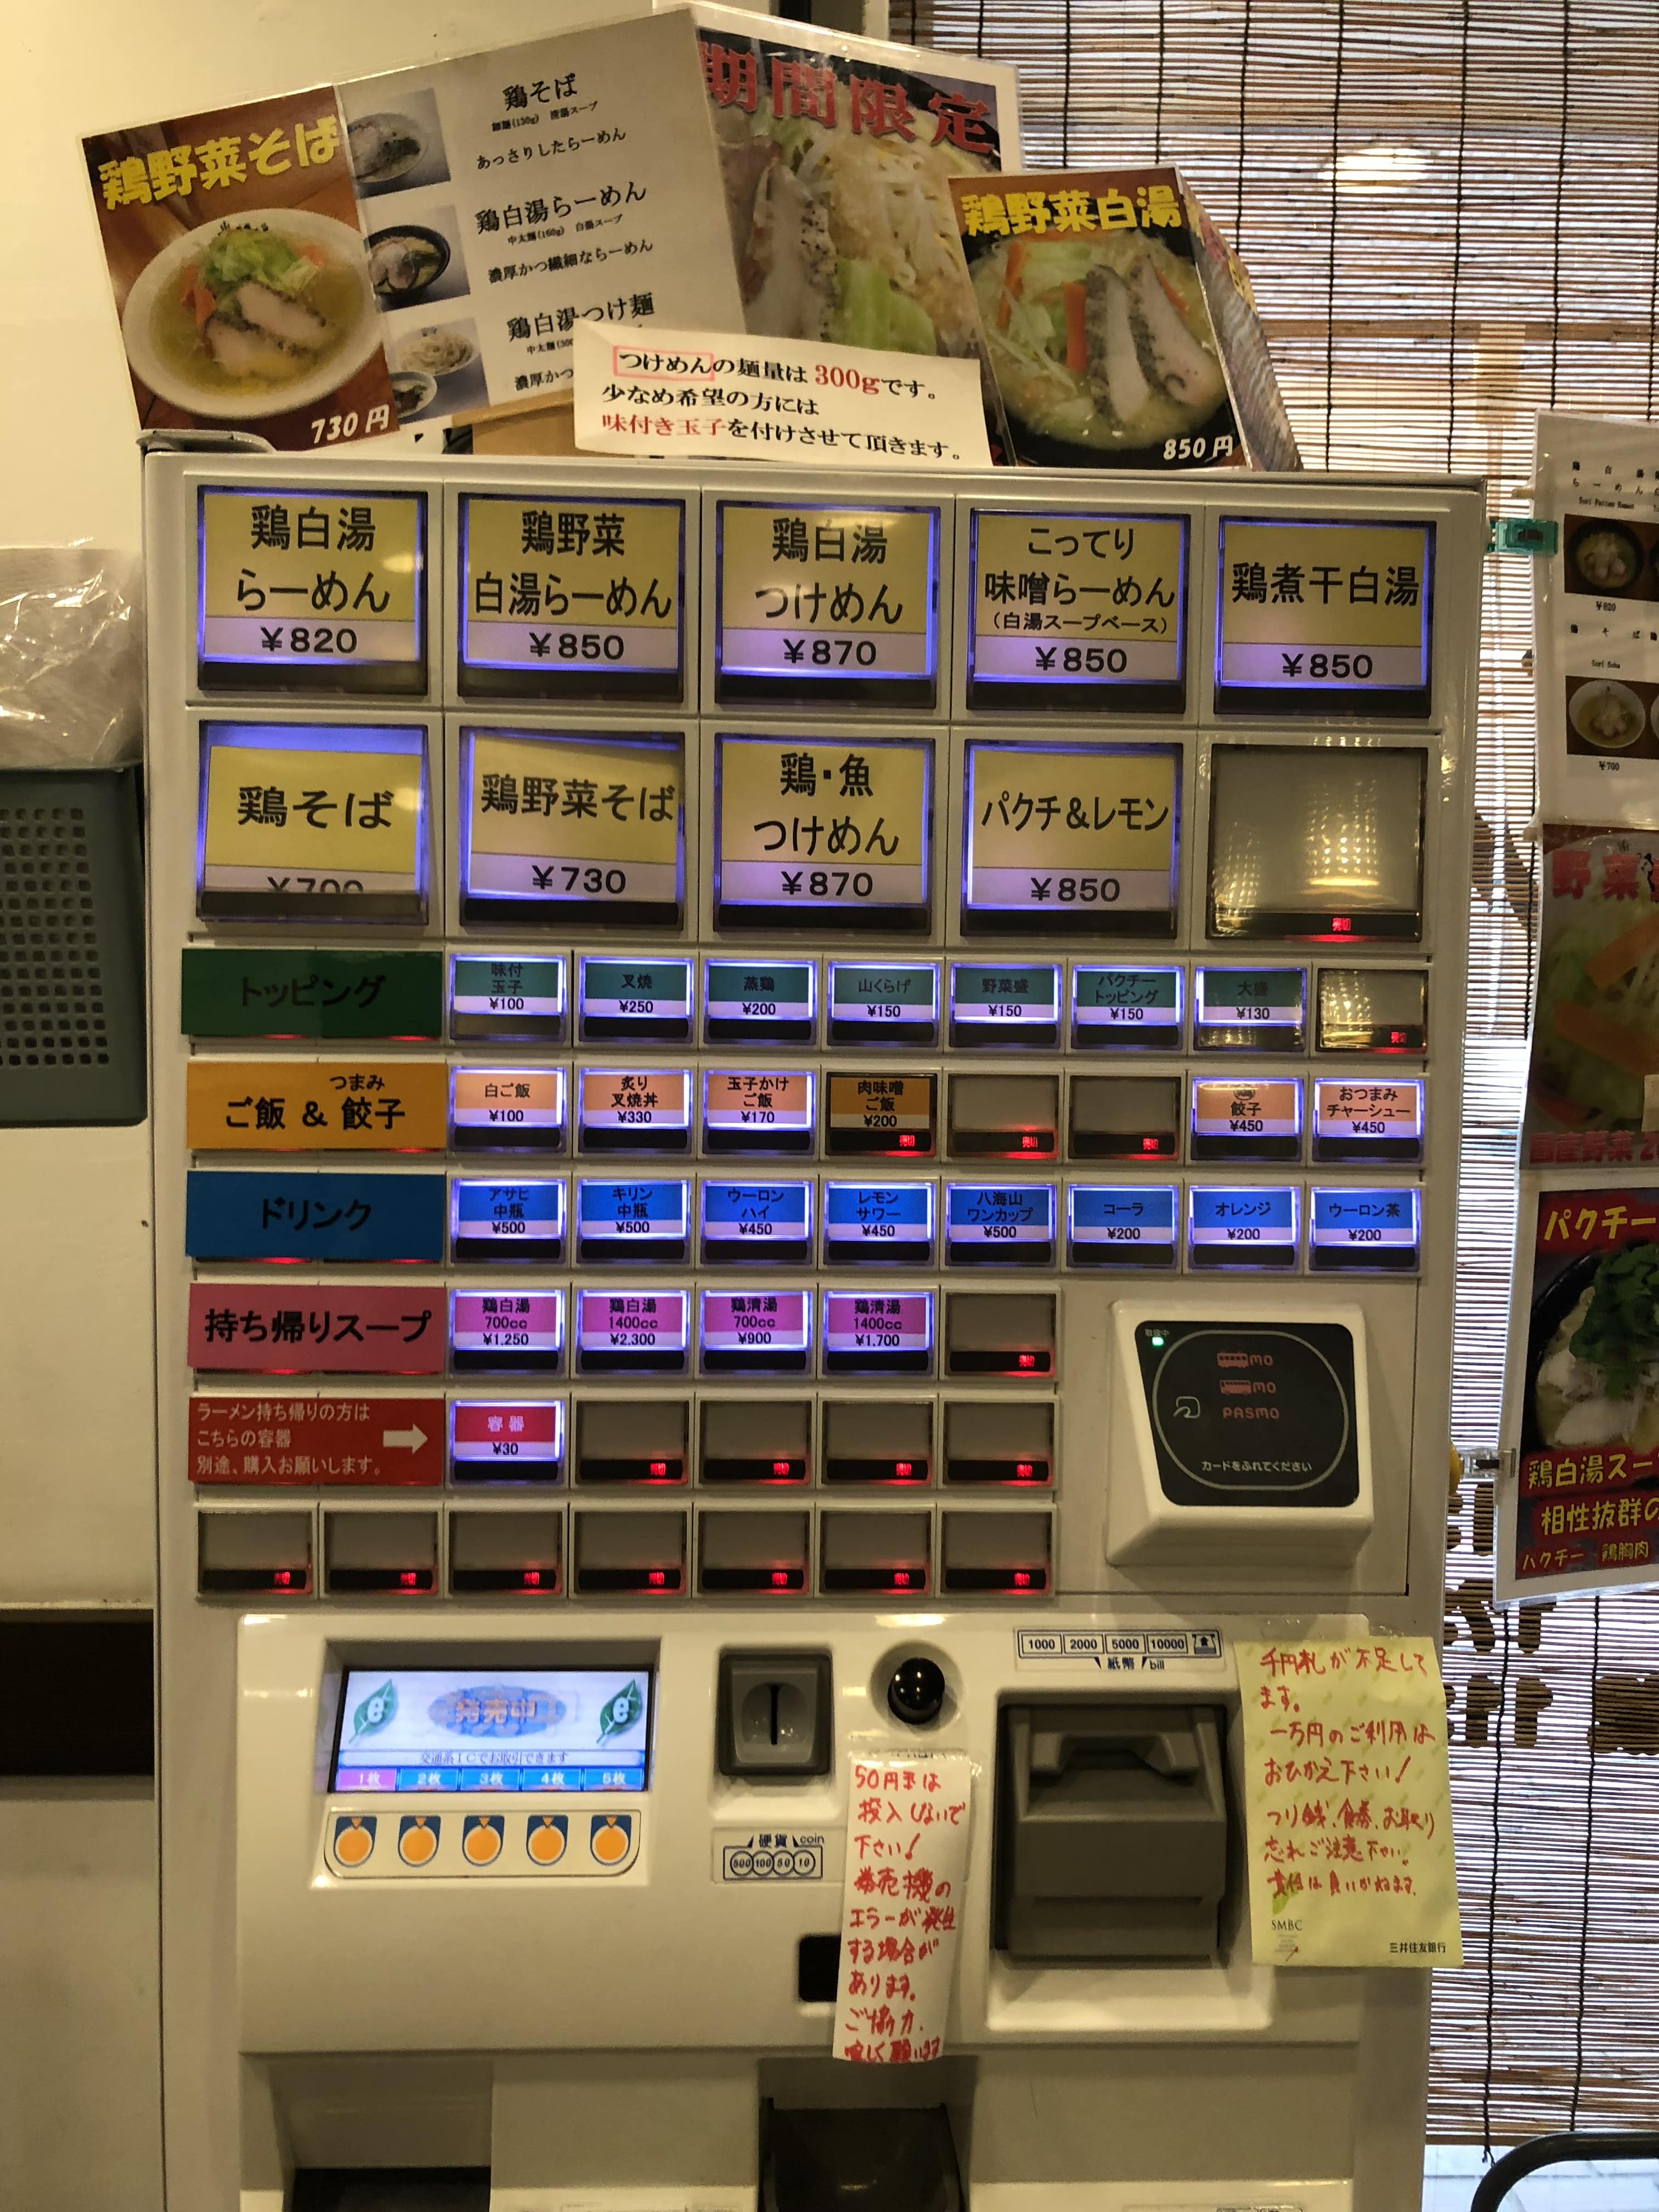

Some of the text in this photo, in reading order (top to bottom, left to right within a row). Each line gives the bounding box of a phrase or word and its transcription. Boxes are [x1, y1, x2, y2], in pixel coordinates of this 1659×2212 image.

[503, 73, 577, 110] 鶏そば
[698, 41, 996, 154] 期間限定
[477, 128, 627, 169] あっさりしたらーめん
[98, 115, 340, 210] 鶏野菜そば
[475, 182, 646, 234] 鶏白湯らーめん
[961, 185, 1183, 237] 鶏野菜白湯
[506, 292, 655, 341] 鶏白湯つけ麺
[602, 384, 820, 416] 少なめ希望の方には
[602, 414, 961, 461] 味付き玉子を付けさせて頂きます。
[251, 503, 376, 552] 鶏白湯
[522, 509, 626, 557] 鶏野菜
[772, 517, 888, 564] 鶏白湯
[1028, 527, 1135, 561] こってり
[236, 568, 390, 613] らーめん
[985, 570, 1176, 608] 味噌らーめん
[1232, 562, 1420, 607] 鶏煮干白湯
[475, 571, 672, 619] 白湯らーめん
[755, 582, 904, 623] つけめん
[260, 626, 358, 653] ¥820
[528, 631, 624, 660] ¥850
[784, 639, 877, 665] ¥870
[1035, 646, 1127, 674] ¥850
[1282, 653, 1373, 679] ¥850
[780, 752, 874, 798] 鶏・魚
[481, 772, 676, 823] 鶏野菜そば
[238, 785, 394, 830] 鶏そば
[981, 790, 1170, 833] パクチ&レモン
[753, 815, 900, 857] つけめん
[532, 864, 627, 895] ¥730
[781, 870, 873, 897] ¥870
[1030, 877, 1120, 902] ¥850
[491, 962, 522, 978] 味付
[491, 980, 522, 995] 玉子
[621, 974, 652, 990] 叉焼
[743, 976, 775, 992] 蒸鶏
[858, 979, 911, 994] 山くらげ
[981, 978, 1029, 995] 野菜盛
[242, 974, 387, 1008] トッピング
[1094, 989, 1159, 1005] トッピング
[489, 998, 524, 1010] ¥100
[619, 1001, 653, 1013] ¥250
[742, 1003, 776, 1015] ¥200
[867, 1005, 901, 1018] ¥150
[988, 1005, 1022, 1017] ¥150
[1110, 1008, 1144, 1020] ¥150
[1236, 1007, 1270, 1020] ¥130
[330, 1073, 385, 1091] つまみ
[727, 1076, 789, 1092] 玉子かけ
[857, 1080, 904, 1096] 肉味噌
[485, 1082, 531, 1099] 白ご飯
[1339, 1087, 1398, 1102] おつまみ
[611, 1092, 658, 1108] 叉焼丼
[743, 1093, 772, 1108] ご飯
[866, 1097, 895, 1113] ご飯
[226, 1096, 406, 1130] ご飯 & 餃子
[489, 1110, 524, 1122] ¥100
[1231, 1101, 1262, 1117] 餃子
[1327, 1104, 1410, 1118] チャーシュー
[617, 1111, 652, 1124] ¥330
[741, 1111, 775, 1124] ¥170
[864, 1115, 897, 1127] ¥200
[1229, 1120, 1263, 1132] ¥450
[1352, 1121, 1385, 1133] ¥450
[489, 1187, 530, 1201] アサヒ
[612, 1187, 653, 1200] キリン
[727, 1189, 784, 1204] ウーロン
[858, 1191, 899, 1204] レモン
[977, 1191, 1023, 1206] 八海山
[263, 1197, 371, 1231] ドリンク
[494, 1203, 524, 1218] 中瓶
[617, 1203, 648, 1218] 中瓶
[741, 1205, 770, 1220] ハイ
[856, 1207, 901, 1222] サワー
[967, 1207, 1033, 1222] ワンカップ
[1103, 1202, 1143, 1216] コーラ
[1215, 1201, 1272, 1217] オレンジ
[1329, 1203, 1401, 1218] ウーロン茶
[492, 1221, 526, 1234] ¥500
[616, 1221, 650, 1233] ¥500
[738, 1223, 772, 1235] ¥450
[862, 1224, 895, 1237] ¥450
[1544, 1206, 1656, 1241] パクチー
[983, 1226, 1017, 1239] ¥500
[1107, 1228, 1141, 1240] ¥200
[1227, 1228, 1260, 1240] ¥200
[1348, 1229, 1381, 1241] ¥200
[482, 1297, 530, 1314] 鶏白湯
[610, 1297, 657, 1314] 鶏白湯
[205, 1307, 432, 1344] 持ち帰りスープ
[485, 1316, 527, 1330] 700cc
[608, 1316, 658, 1330] 1400cc
[733, 1315, 776, 1329] 700cc
[853, 1317, 902, 1331] 1400cc
[738, 1332, 771, 1344] ¥900
[197, 1402, 370, 1423] ラーメン持ち帰りの方は
[1222, 1407, 1279, 1420] PASMO
[197, 1429, 291, 1449] こちらの容器
[492, 1443, 518, 1455] ¥30
[196, 1456, 381, 1476] 別途、購入お願いします。
[1201, 1460, 1312, 1472] カードをふれてください
[1029, 1639, 1184, 1650] 1000 2000 5000 10000
[1150, 1660, 1165, 1670] bill
[1260, 1646, 1427, 1677] 千円札が不足して
[1260, 1685, 1300, 1712] ます。
[1270, 1720, 1436, 1748] 一万円のご利用は
[854, 1764, 941, 1792] 50円玉は
[857, 1797, 966, 1825] 投入しないで
[800, 1833, 825, 1844] coin
[733, 1858, 810, 1869] 500 100 50 10
[854, 1866, 952, 1903] 券売機の
[850, 1905, 956, 1934] エラーが発生
[1271, 1919, 1303, 1931] SMBC
[847, 1936, 939, 1966] する場合が
[1389, 1942, 1446, 1953] 三井住友銀行
